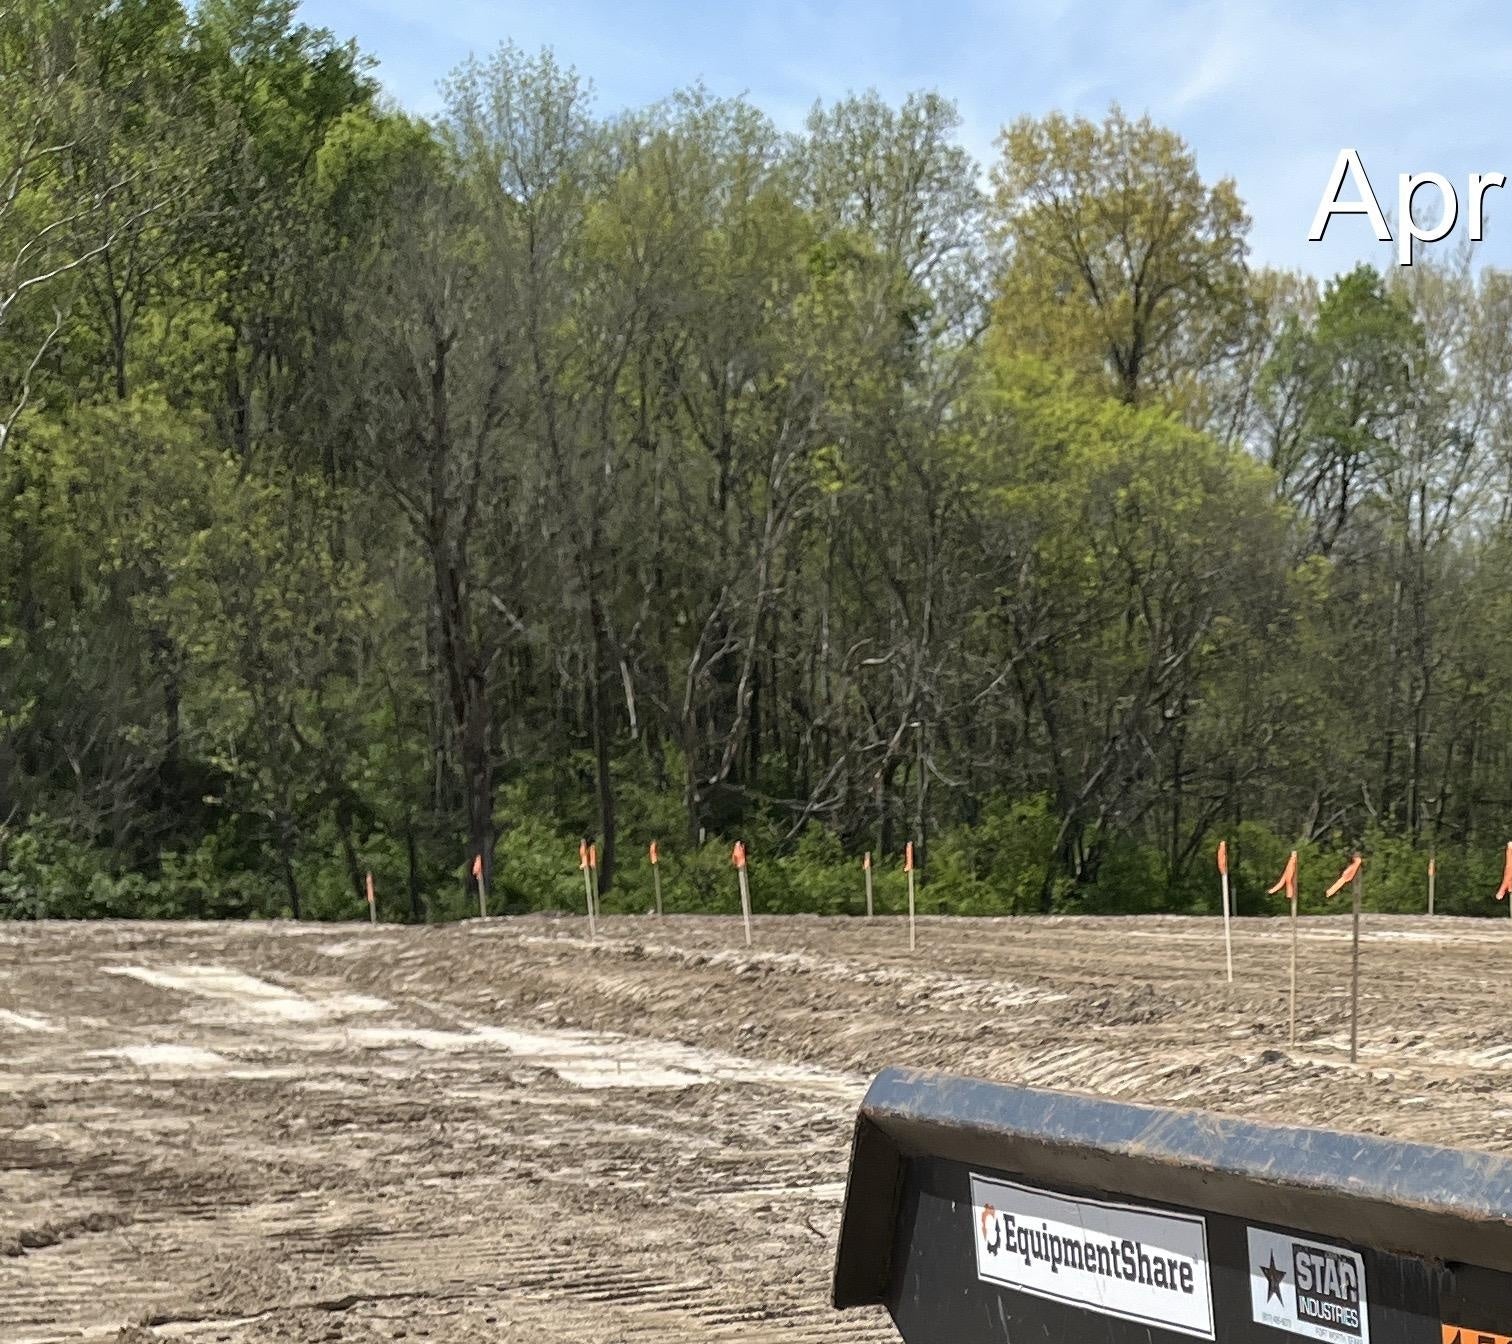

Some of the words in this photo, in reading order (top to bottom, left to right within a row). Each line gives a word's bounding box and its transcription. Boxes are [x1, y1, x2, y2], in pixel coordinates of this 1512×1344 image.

[1004, 1213, 1195, 1295] EquipmentShare
[1295, 1251, 1358, 1303] STAR
[1298, 1295, 1359, 1328] INDUSTRIES
